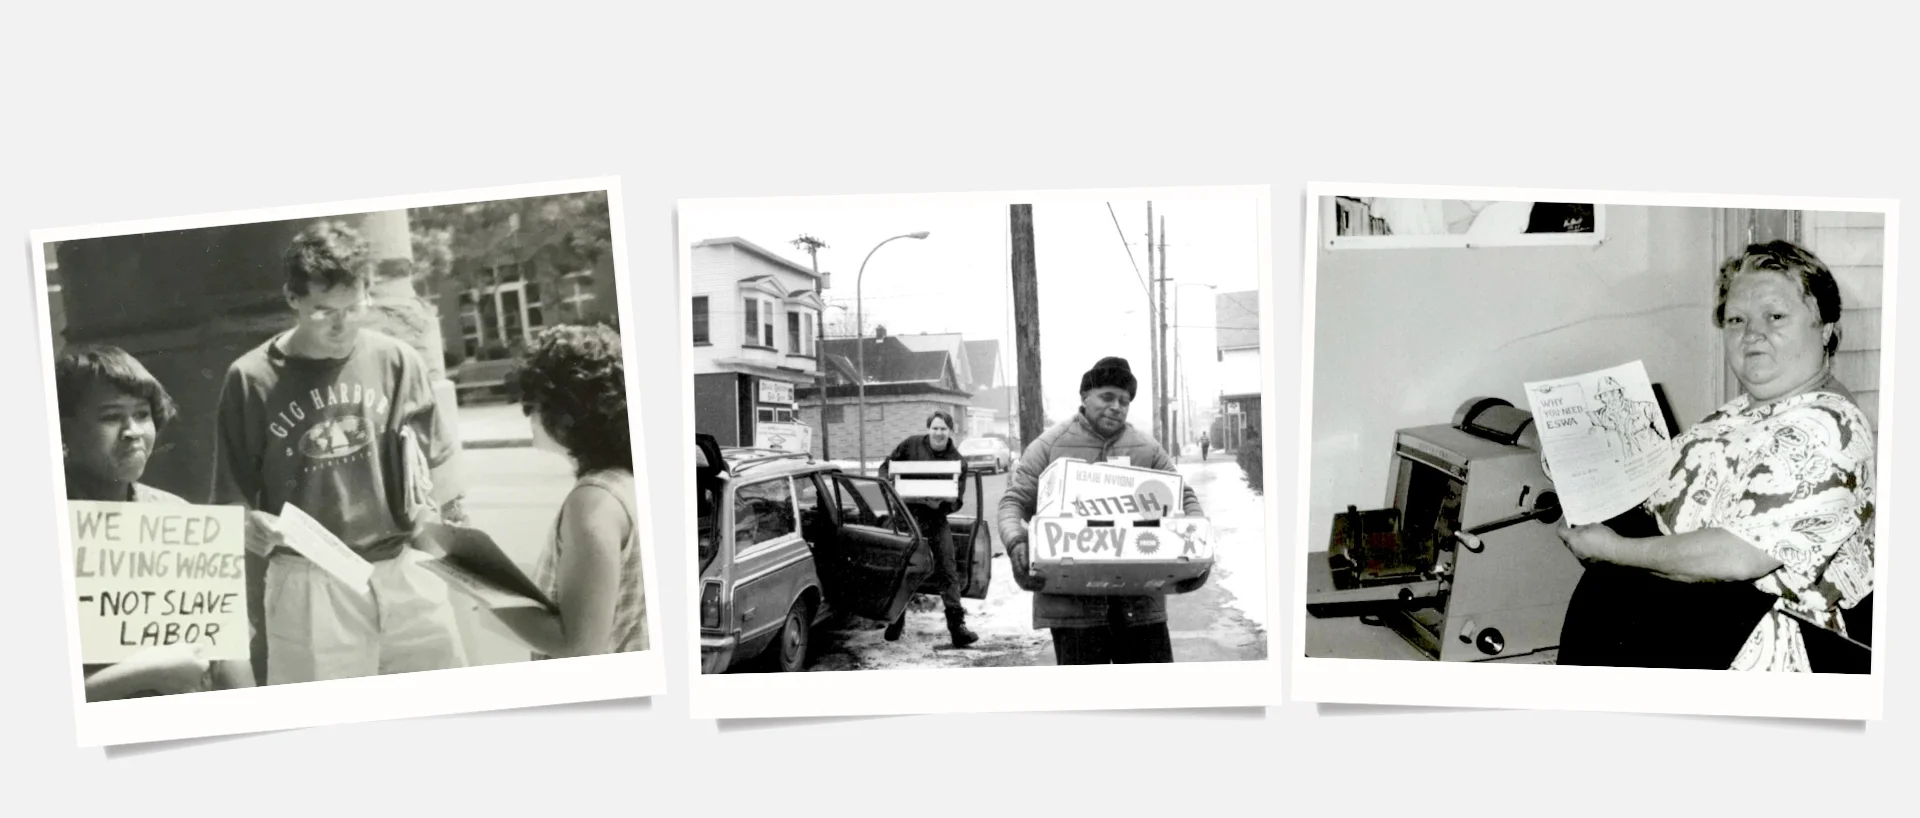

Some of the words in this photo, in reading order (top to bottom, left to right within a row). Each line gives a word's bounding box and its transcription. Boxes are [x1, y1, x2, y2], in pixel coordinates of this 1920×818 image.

[269, 400, 305, 438] GIG
[310, 383, 388, 414] HARBOR
[1540, 397, 1563, 408] WHY
[1544, 408, 1561, 418] YOU
[1561, 405, 1583, 416] NEED
[1546, 417, 1579, 430] ESWA
[1076, 469, 1101, 484] RIVER
[1104, 473, 1135, 488] INDIAN
[1071, 492, 1161, 517] HELLER
[76, 510, 122, 541] WE
[139, 514, 220, 545] NEED
[1044, 522, 1126, 557] Prexy
[76, 547, 170, 579] LIVING
[176, 552, 244, 579] WAGES
[161, 590, 238, 616] SLAVE
[120, 621, 220, 646] LABOR
